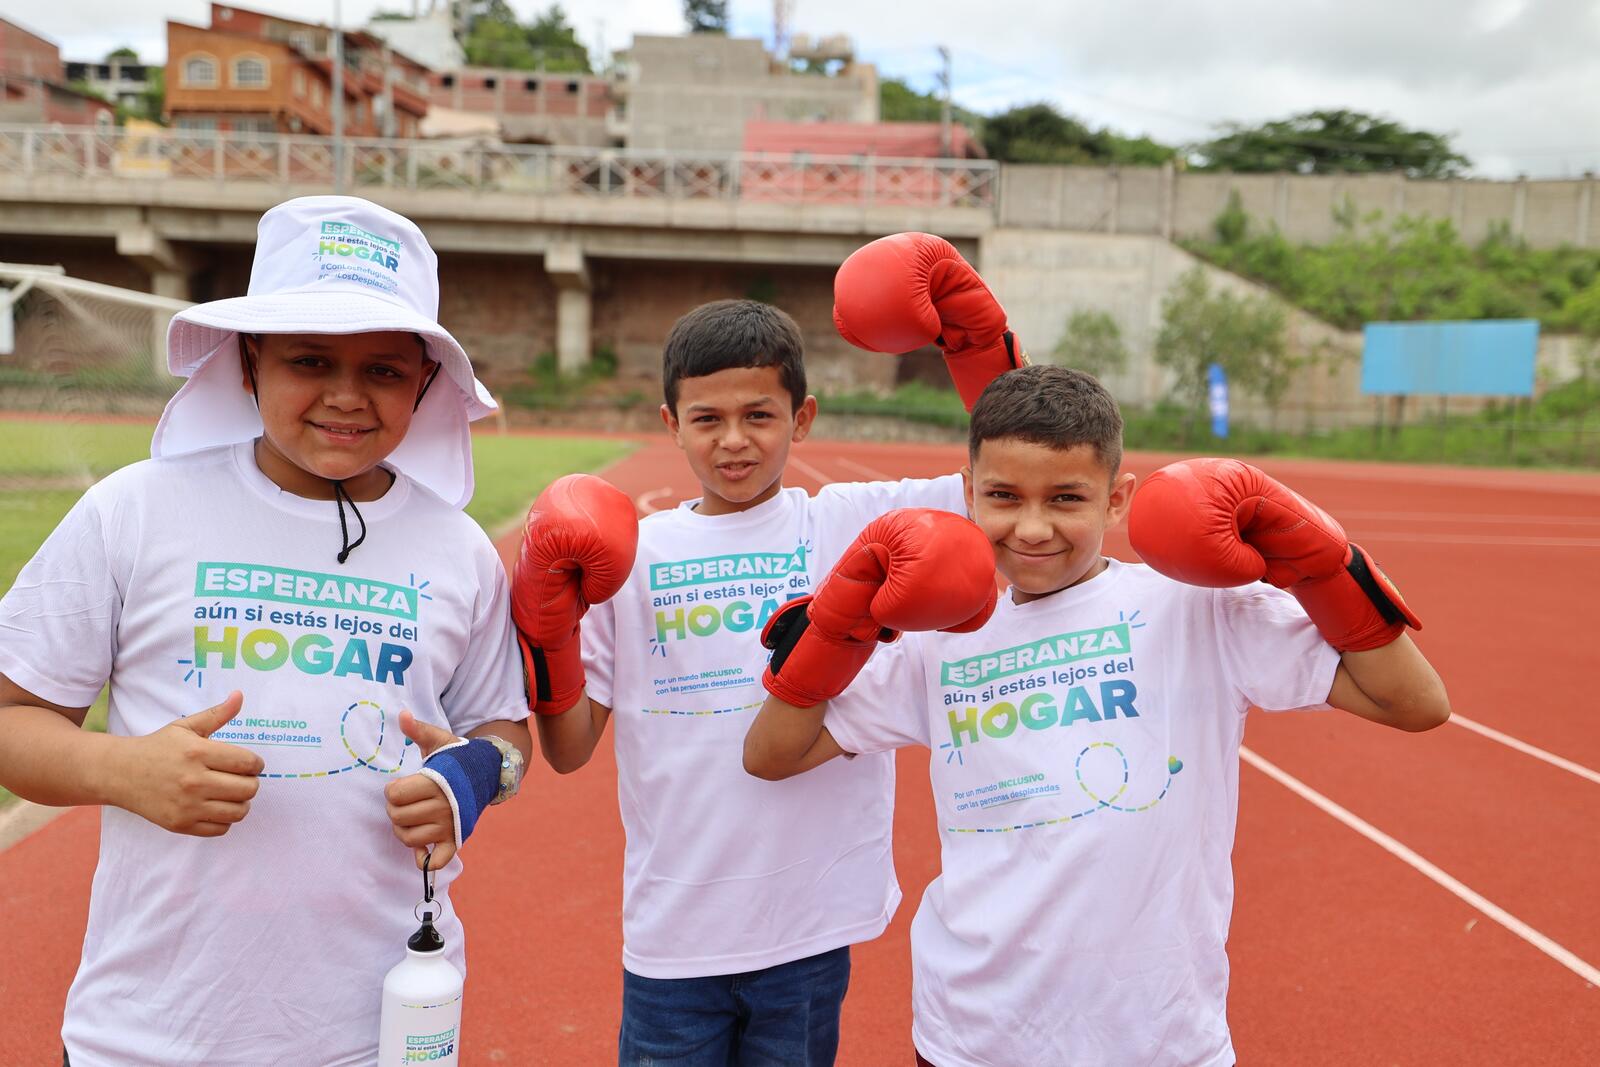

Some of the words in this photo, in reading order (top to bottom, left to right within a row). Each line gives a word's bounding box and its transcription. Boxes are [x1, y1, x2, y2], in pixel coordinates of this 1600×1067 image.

[319, 240, 399, 272] HOGAR
[656, 556, 803, 586] ESPERANZA
[204, 567, 412, 614] ESPERANZA
[653, 591, 682, 607] aún
[686, 588, 699, 602] si
[703, 583, 746, 600] estás
[750, 582, 785, 595] lejos
[789, 575, 811, 588] del
[194, 601, 237, 621] aún
[244, 604, 263, 621] si
[270, 609, 327, 628] estás
[334, 613, 383, 636] lejos
[389, 622, 418, 642] del
[655, 592, 809, 643] HOGA
[194, 625, 414, 686] HOGAR
[948, 630, 1124, 684] ESPERANZA
[654, 678, 666, 686] Por
[678, 674, 699, 682] mundo
[700, 667, 742, 679] INCLUSIVO
[681, 682, 709, 693] personas
[711, 676, 755, 687] desplazadas
[944, 688, 976, 705] aún
[982, 685, 994, 702] si
[999, 673, 1047, 696] estás
[1053, 665, 1098, 687] lejos
[1103, 657, 1134, 675] del
[245, 718, 307, 729] INCLUSIVO
[948, 679, 1140, 748] HOGAR
[258, 731, 322, 743] desplazadas
[954, 792, 965, 800] Por
[975, 784, 998, 794] mundo
[998, 773, 1045, 789] INCLUSIVO
[957, 803, 969, 811] con
[969, 800, 979, 808] las
[980, 794, 1010, 807] personas
[1010, 784, 1060, 798] desplazadas
[406, 1044, 454, 1061] HOGAR
[408, 1031, 454, 1043] ESPERANZA
